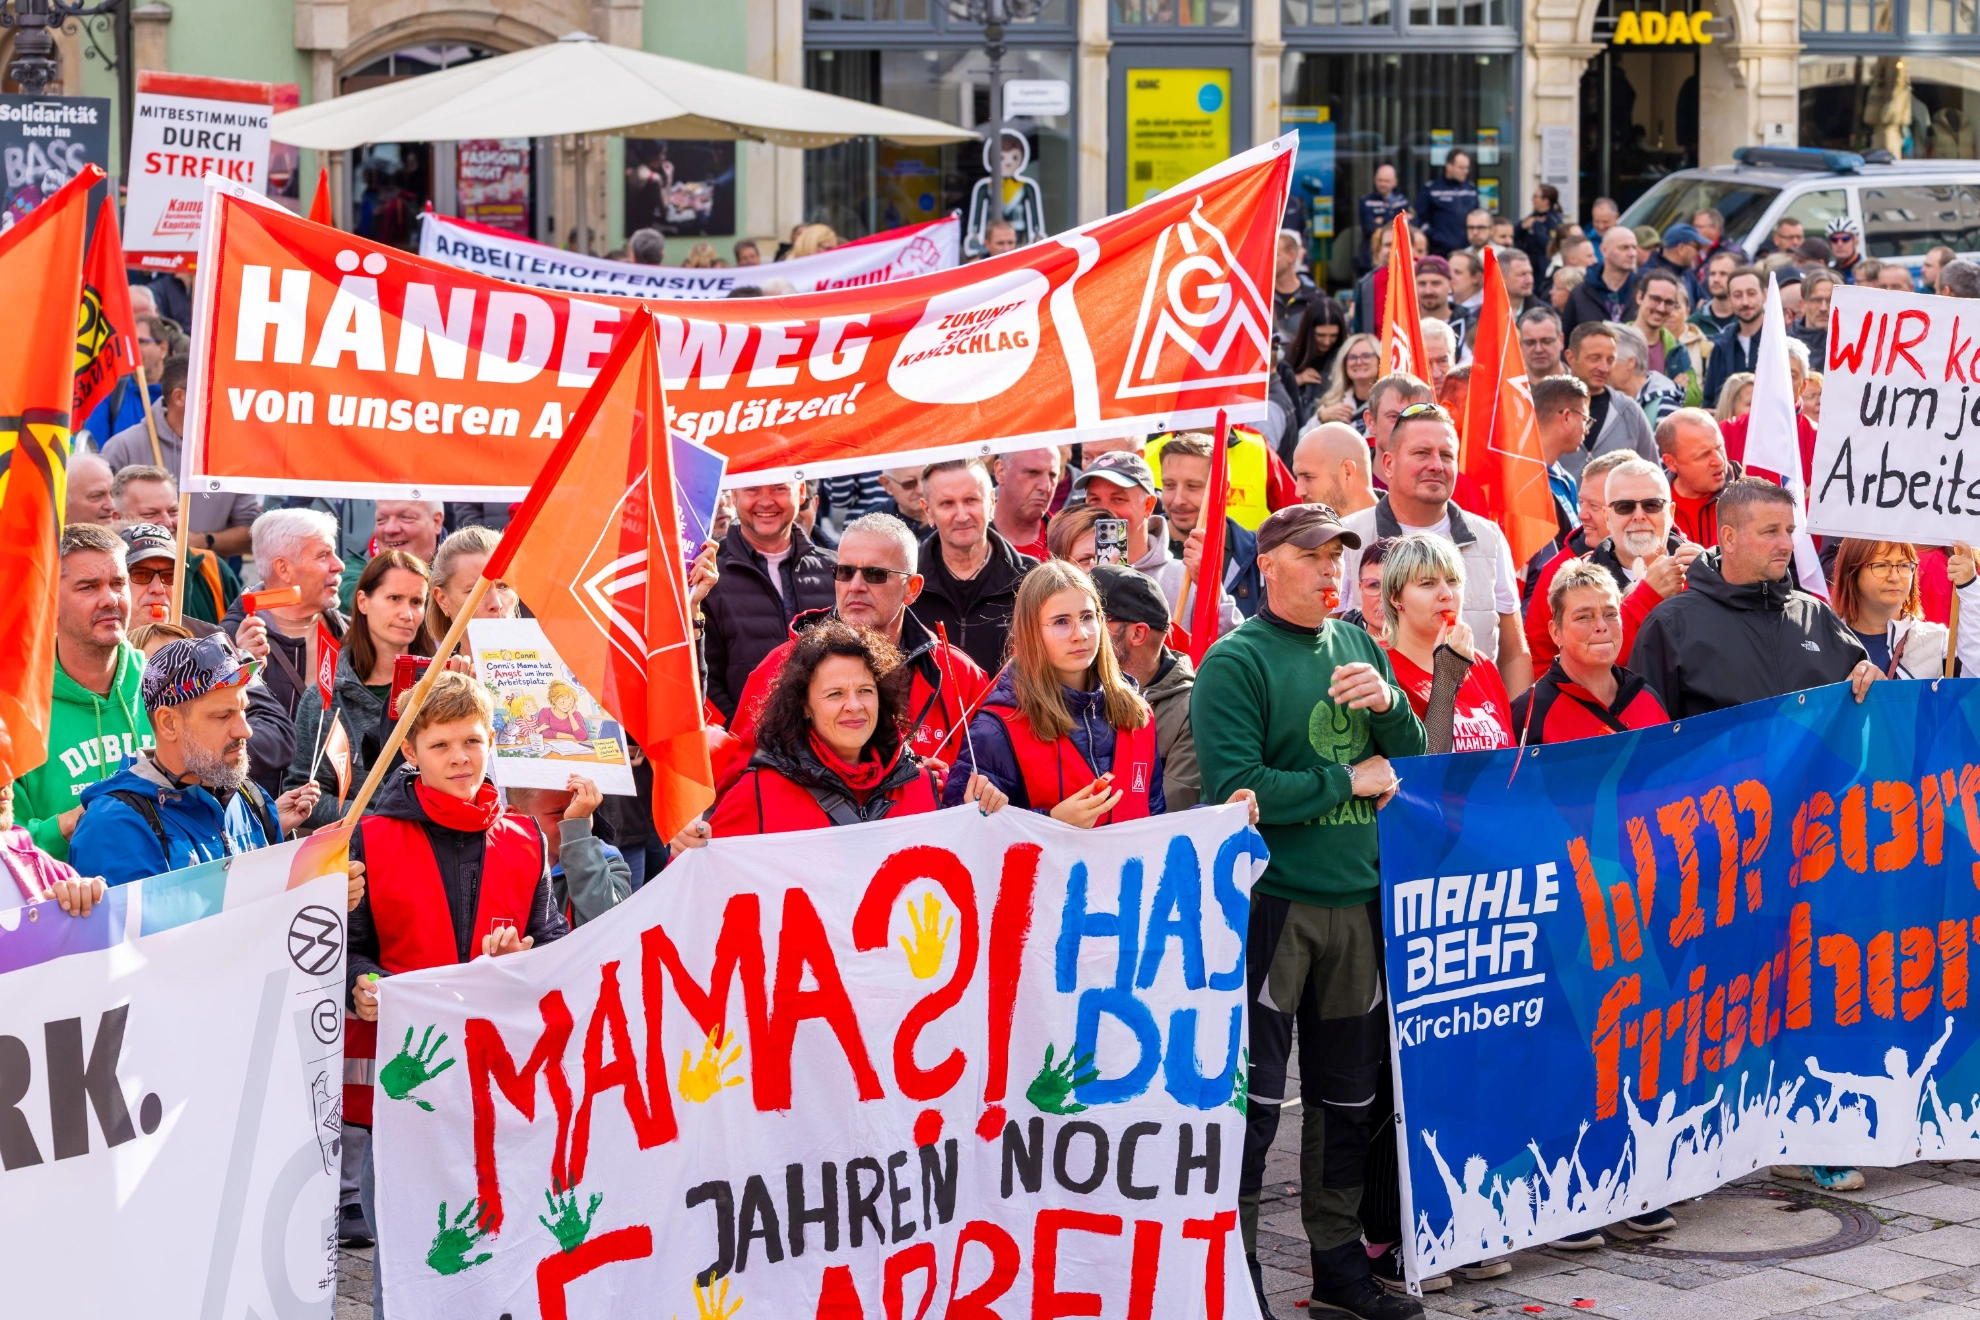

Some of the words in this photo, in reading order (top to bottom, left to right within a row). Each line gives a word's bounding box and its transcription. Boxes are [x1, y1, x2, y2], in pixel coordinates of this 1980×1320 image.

[1613, 10, 1713, 45] ADAC
[0, 103, 98, 125] Solidarität
[22, 124, 52, 137] bebt
[54, 125, 71, 138] im
[140, 105, 268, 129] MITBESTIMMUNG
[163, 127, 241, 152] DURCH
[4, 139, 88, 188] BASS
[145, 152, 255, 184] STREIK!
[168, 198, 203, 212] Kamp
[435, 234, 735, 291] ARBEITEROFFENSIVE
[235, 249, 621, 389] HÄNDE
[654, 311, 873, 391] WEG
[938, 300, 1027, 331] ZUKUNFT
[942, 319, 1000, 343] STATT
[897, 330, 1029, 368] KAHLSCHLAG
[1829, 306, 1931, 380] WIR
[227, 386, 316, 425] von
[327, 393, 521, 438] unseren
[530, 382, 865, 446] Atsplätzen!
[486, 662, 515, 670] Conni's
[514, 652, 536, 660] Conni
[494, 669, 522, 680] Angst
[497, 678, 548, 687] Arbeitsplatz.
[60, 732, 157, 778] DUBLI
[1456, 735, 1493, 751] MAHLE
[1567, 779, 1772, 971] WIR
[1394, 862, 1559, 937] MAHLE
[1407, 922, 1538, 993] BEHR
[1398, 997, 1544, 1050] Kirchberg
[1074, 988, 1242, 1111] DU
[686, 1139, 958, 1287] JAHREN
[1001, 1116, 1220, 1200] NOCH
